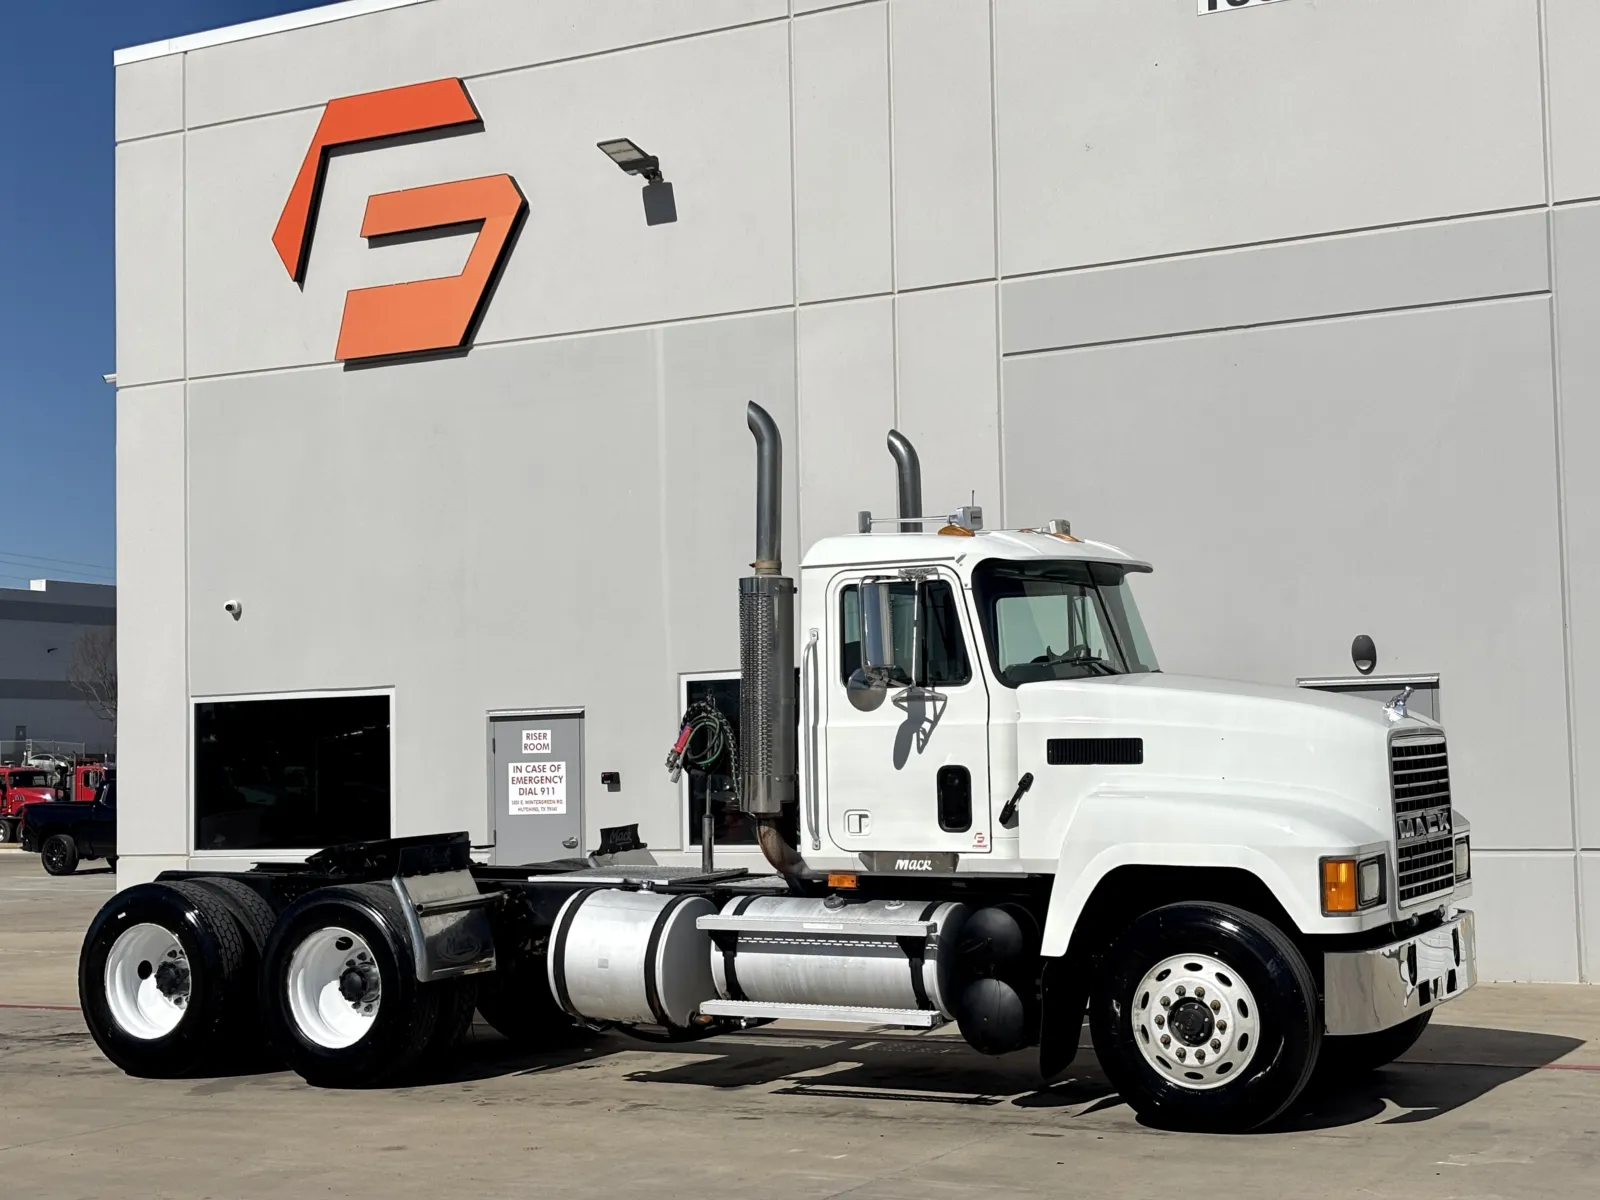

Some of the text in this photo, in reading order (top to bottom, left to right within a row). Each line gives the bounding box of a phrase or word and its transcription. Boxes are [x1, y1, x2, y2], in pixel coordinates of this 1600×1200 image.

[526, 732, 548, 741] RISER
[523, 742, 550, 751] ROOM
[512, 764, 562, 774] IN CASE OF
[511, 775, 564, 785] EMERGENCY
[518, 786, 555, 796] DIAL 911
[1398, 812, 1451, 839] MACK
